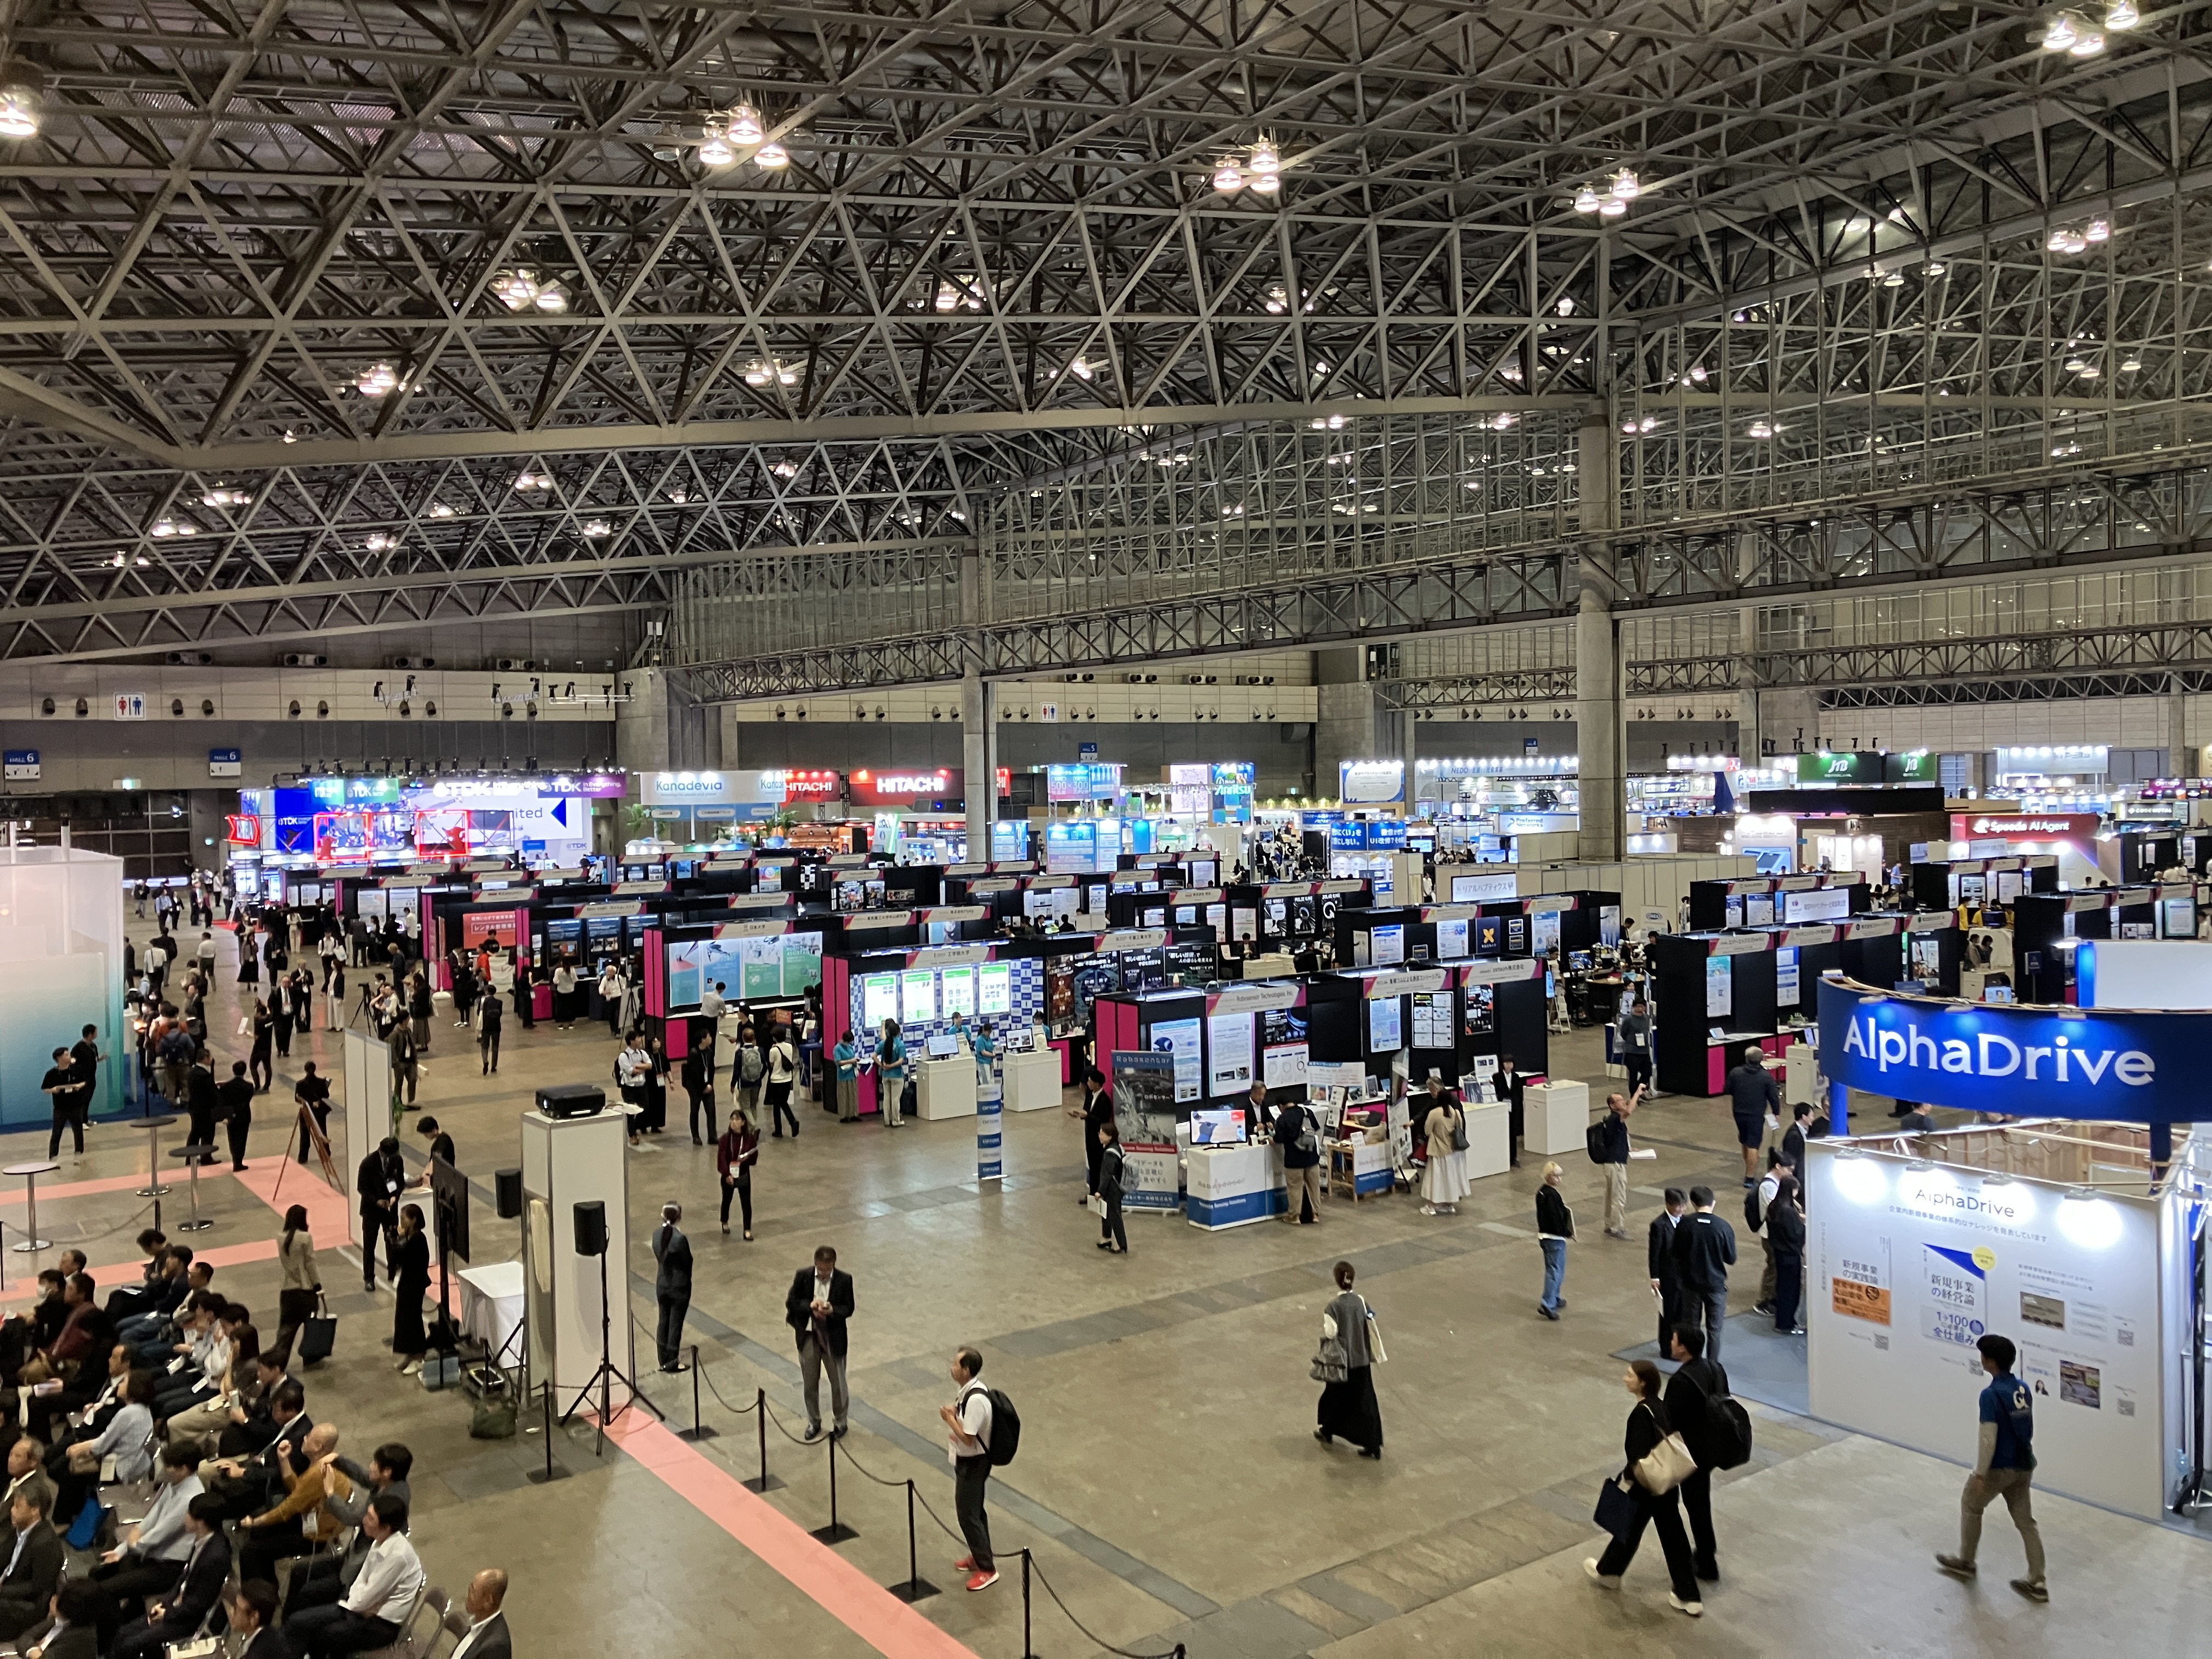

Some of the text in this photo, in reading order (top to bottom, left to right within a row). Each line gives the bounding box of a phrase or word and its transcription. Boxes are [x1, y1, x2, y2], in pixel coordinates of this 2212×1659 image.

[27, 753, 34, 763] 6
[229, 751, 236, 760] 6
[1829, 760, 1848, 774] JTB
[1905, 758, 1918, 772] JTB
[446, 782, 490, 797] TDK
[551, 782, 582, 792] TDK
[657, 780, 722, 791] Kanadevia
[785, 782, 832, 792] HITACHI
[877, 777, 944, 793] HITACHI
[1052, 782, 1066, 790] 500
[1073, 781, 1088, 790] 300
[1215, 785, 1251, 796] Anritsu
[1703, 783, 1715, 791] ALL
[353, 786, 373, 797] TDK
[283, 817, 298, 825] TDK
[1990, 821, 2027, 833] Speeda
[2040, 821, 2069, 833] Agent
[1463, 883, 1507, 893] リアルハプティクス
[1843, 1015, 2155, 1086] AlphaDrive
[1116, 1054, 1170, 1064] Robosensor
[1915, 1189, 2015, 1218] AlphaDrive
[1843, 1259, 1878, 1276] 新規事業
[1932, 1274, 1975, 1294] 新規事業
[1932, 1286, 1975, 1306] の経営論
[1934, 1327, 1975, 1346] 全仕組み
